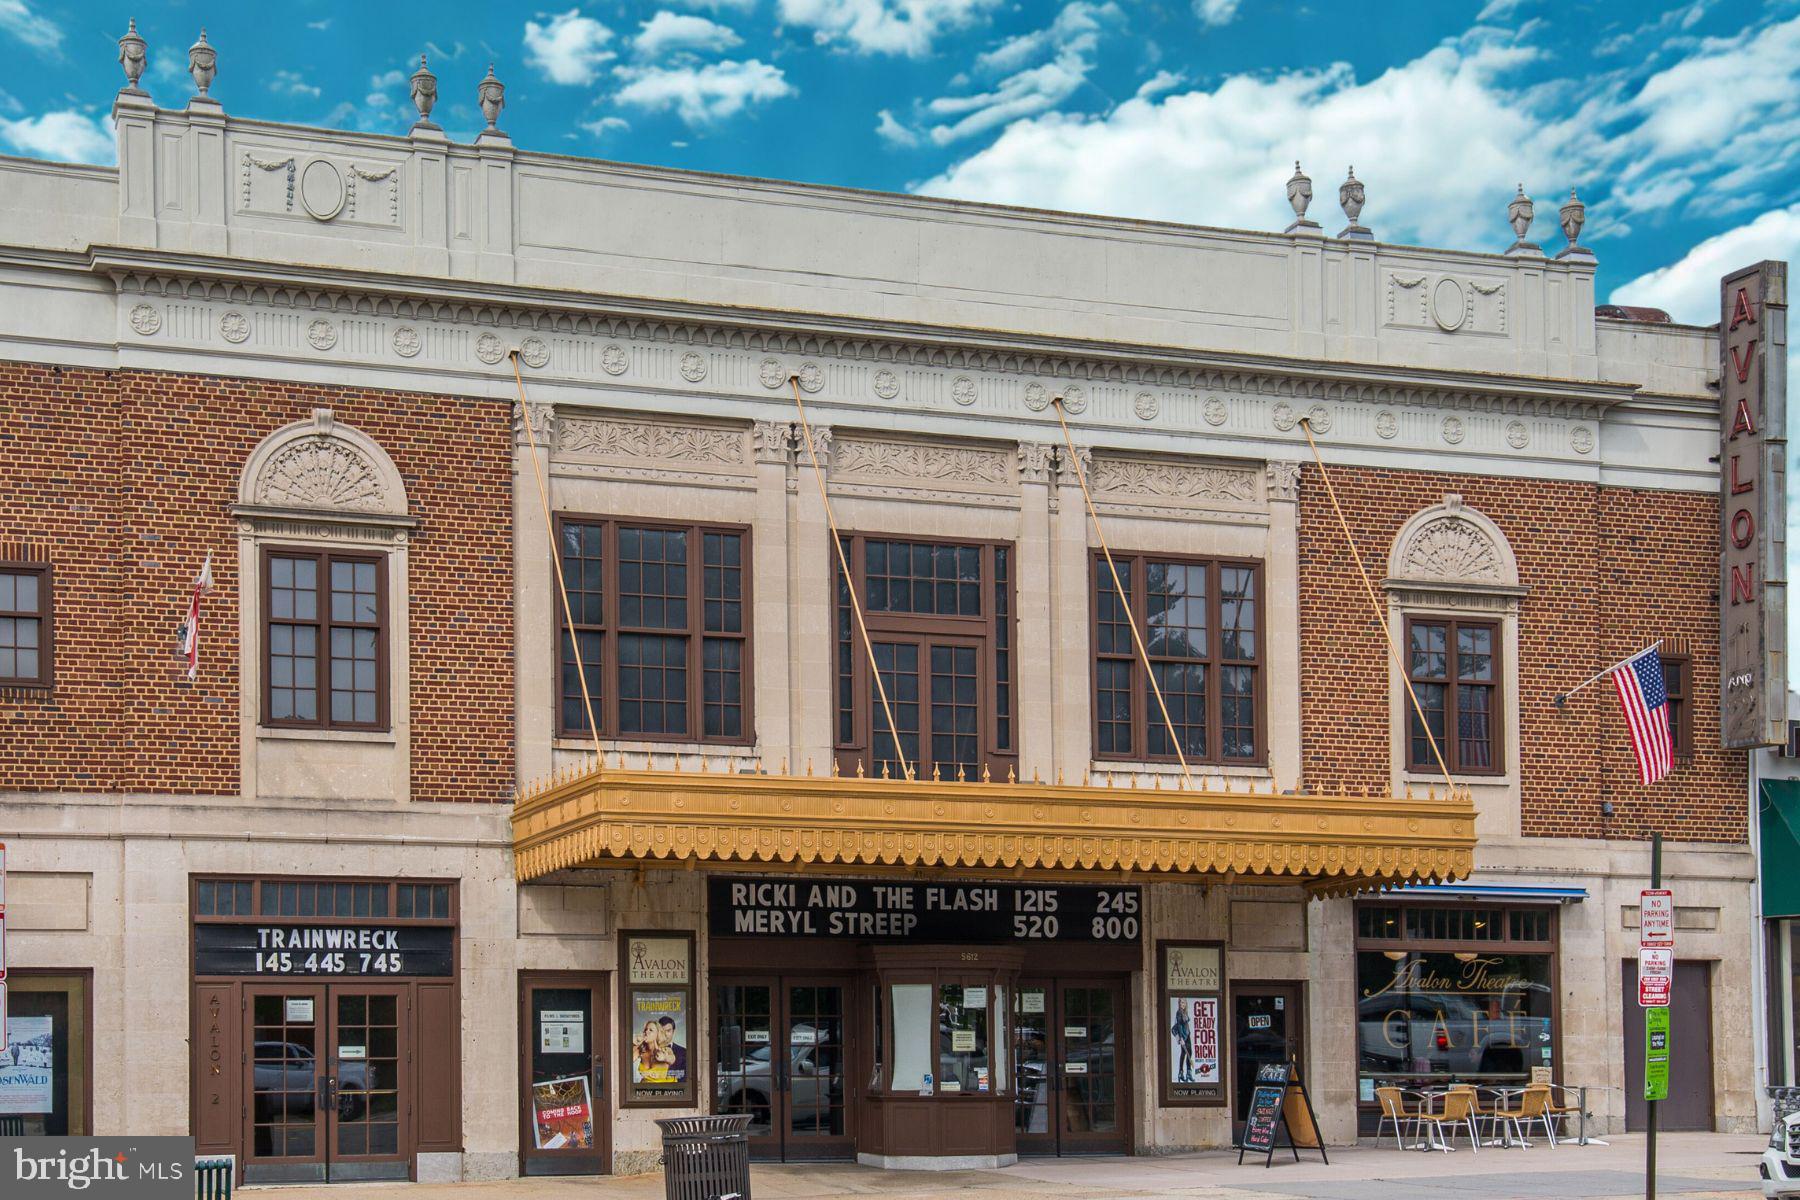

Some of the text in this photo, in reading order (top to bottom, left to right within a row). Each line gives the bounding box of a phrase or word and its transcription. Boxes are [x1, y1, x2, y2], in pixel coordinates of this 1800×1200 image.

[1729, 287, 1757, 606] AVALON
[732, 883, 1138, 914] RICKI AND THE FLASH 1215 245
[1651, 900, 1662, 908] NO
[1643, 910, 1670, 918] PARKING
[735, 909, 1138, 940] MERYL STREEP 520 800
[257, 928, 399, 950] TRAINWRECK
[256, 952, 402, 973] 145 445 745
[632, 953, 686, 970] AVALON
[961, 952, 979, 961] 5612
[632, 970, 687, 979] THEATRE
[1170, 960, 1217, 978] AVALON
[1170, 978, 1218, 986] THEATRE
[1363, 957, 1533, 998] Avalon Theatre
[636, 1000, 681, 1012] TRAINWRECK
[1193, 1001, 1216, 1018] GET
[1193, 1018, 1216, 1029] READY
[1250, 1016, 1270, 1027] OPEN
[1382, 999, 1531, 1049] CAFÉ
[1194, 1030, 1216, 1045] FOR
[1194, 1045, 1217, 1059] RICKI
[0, 1073, 48, 1086] SENWALD
